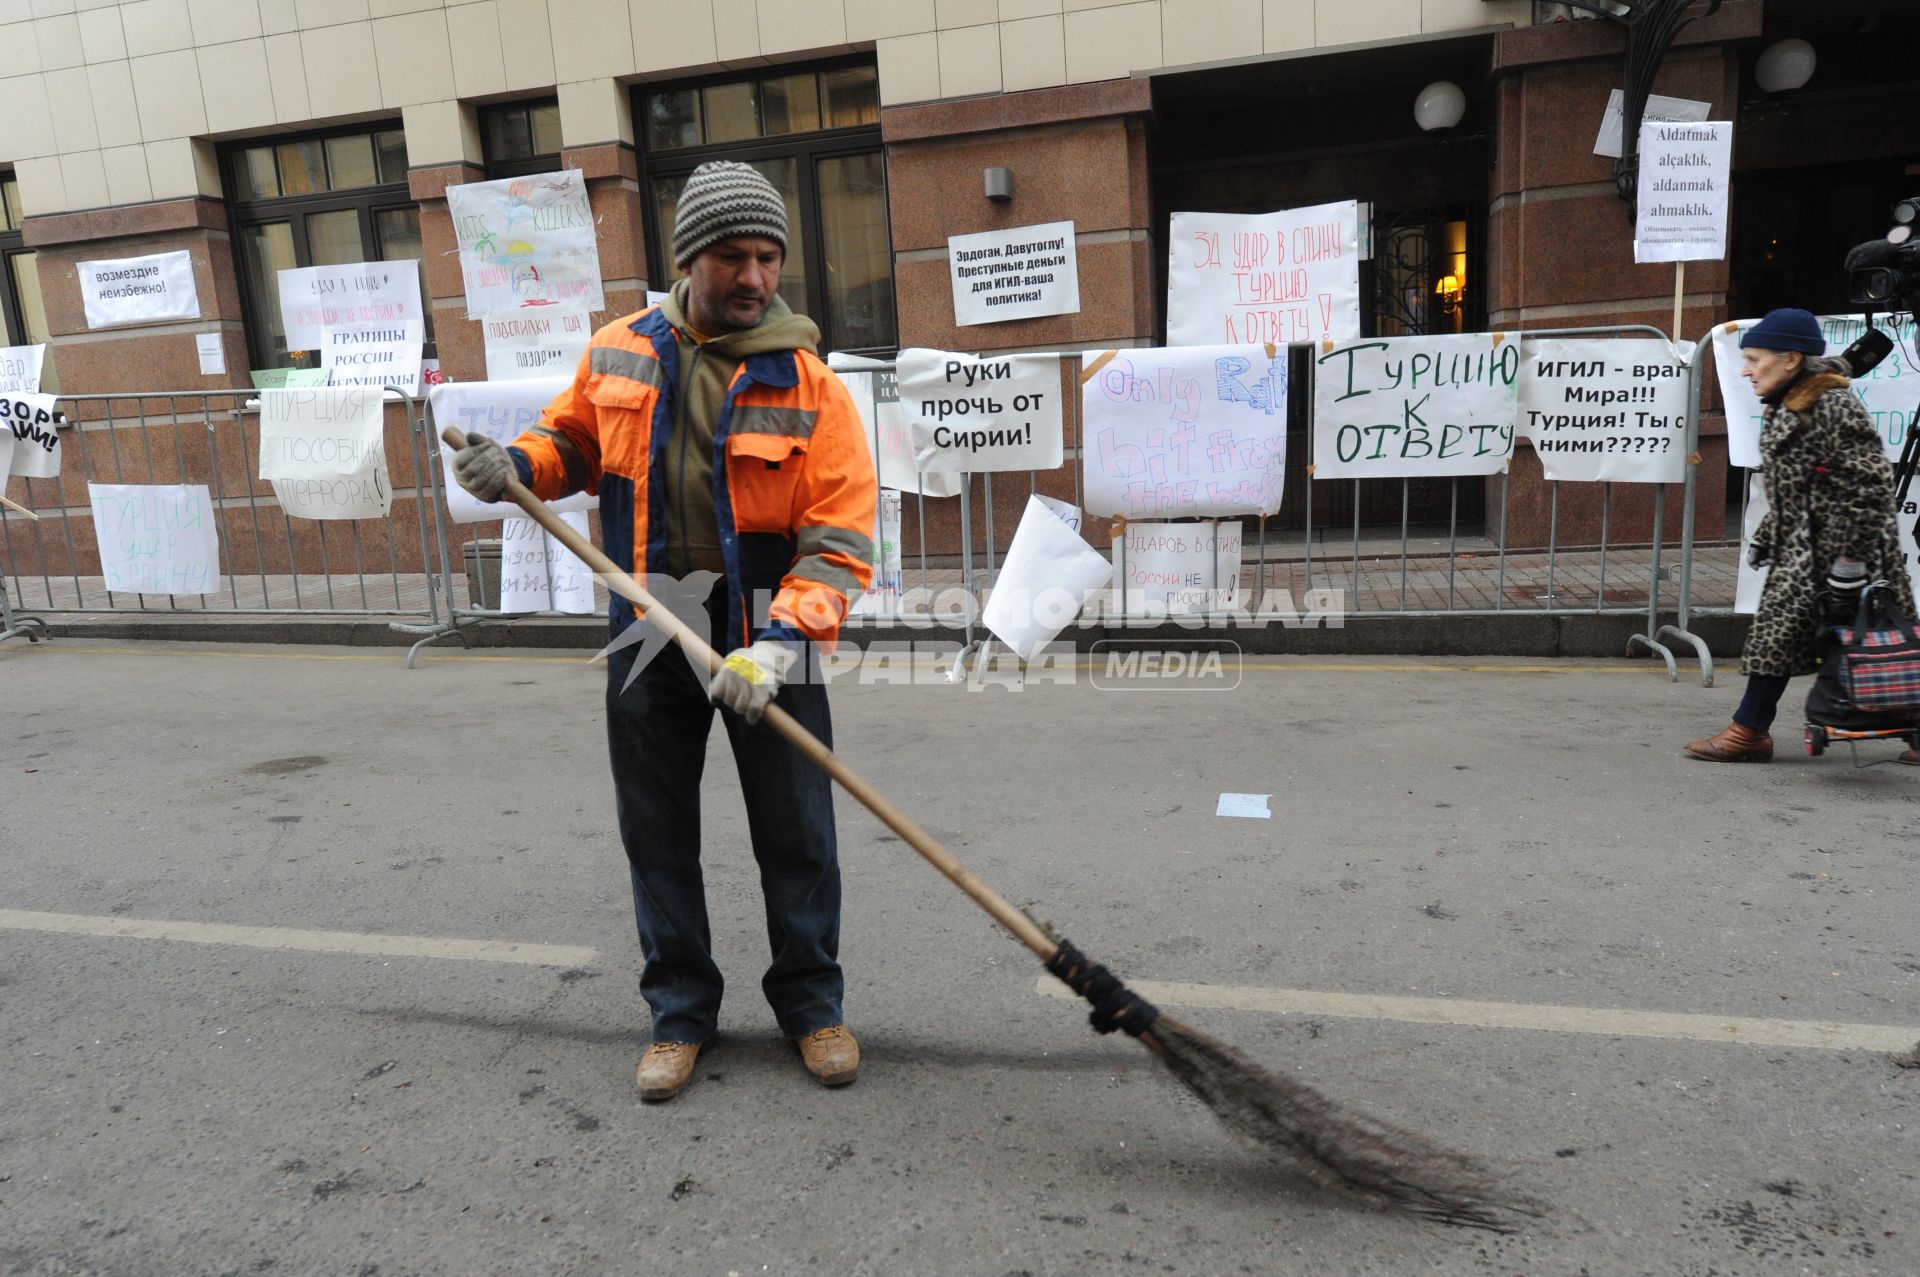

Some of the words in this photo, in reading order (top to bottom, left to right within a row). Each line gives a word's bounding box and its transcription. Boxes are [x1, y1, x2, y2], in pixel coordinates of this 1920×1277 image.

[1656, 128, 1718, 141] Aldatmak
[1659, 153, 1711, 169] alçaklık,
[1653, 178, 1714, 192] aldanmak
[1651, 203, 1713, 217] ahmaklık.
[454, 214, 491, 241] RATS
[1005, 237, 1065, 257] Давутоглу!
[1194, 231, 1221, 269] ЗА
[1233, 231, 1268, 270] УДАР
[1277, 231, 1285, 266] В
[1292, 222, 1342, 264] СПИНУ
[96, 265, 160, 283] возмездие
[958, 260, 1024, 279] Преступные
[1026, 255, 1066, 271] деньги
[99, 280, 167, 300] неизбежно!
[972, 280, 993, 294] для
[994, 273, 1054, 289] ИГИЛ-ваша
[1230, 268, 1308, 302] ТУРЦИЮ
[985, 289, 1042, 307] политика!
[333, 330, 406, 344] ГРАНИЦЫ
[1226, 313, 1238, 344] К
[335, 351, 393, 366] РОССИИ
[516, 349, 563, 368] ПОЗОР!!!
[945, 360, 1011, 387] Руки
[1537, 361, 1606, 377] ИГИЛ
[1632, 364, 1682, 381] враг
[1100, 357, 1200, 422] Only
[1564, 386, 1656, 406] Мира!!!
[921, 397, 1003, 421] прочь
[1013, 393, 1043, 411] от
[1405, 392, 1431, 429] К
[458, 405, 541, 440] ТУР
[1527, 411, 1626, 431] Турция!
[1635, 411, 1668, 428] Ты
[1674, 416, 1684, 429] с
[934, 422, 1031, 453] Сирии!
[1539, 437, 1671, 453] ними?????
[283, 436, 382, 465] ПОСОБНИК
[1098, 421, 1195, 483] hit
[91, 494, 202, 534] ТУРЦИЯ
[118, 534, 179, 562] УДАР
[1185, 572, 1202, 587] НЕ
